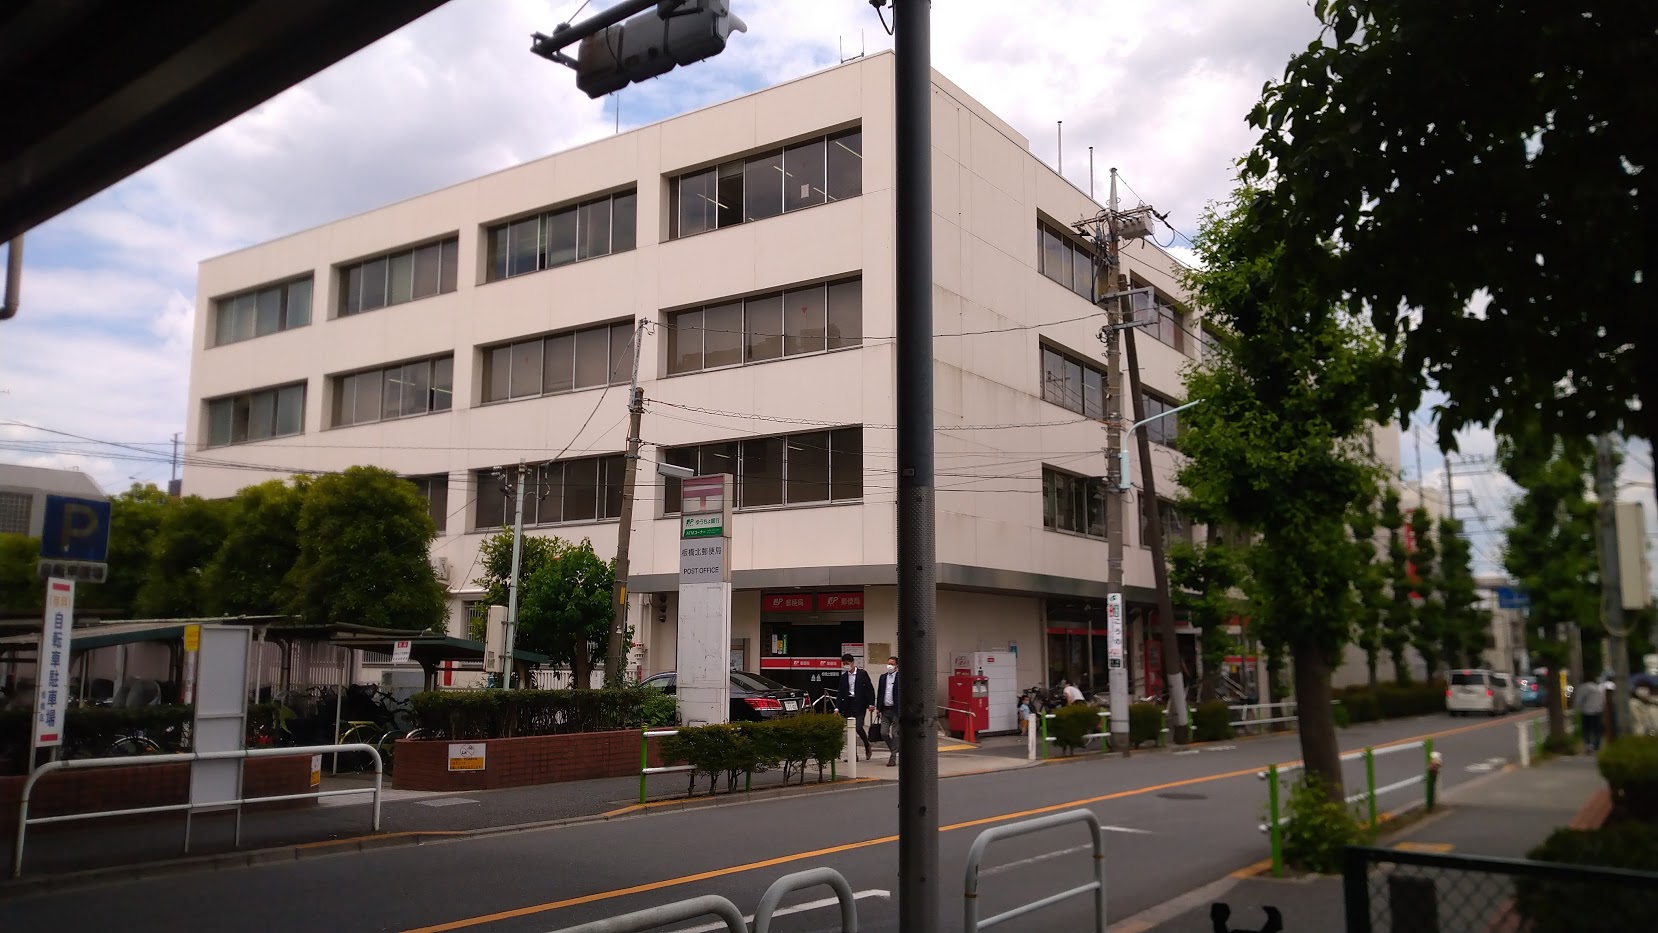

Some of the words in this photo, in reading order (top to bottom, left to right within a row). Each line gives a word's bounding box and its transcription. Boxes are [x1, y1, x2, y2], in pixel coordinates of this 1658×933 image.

[60, 503, 98, 552] P
[682, 546, 722, 556] 板橋北郵便局
